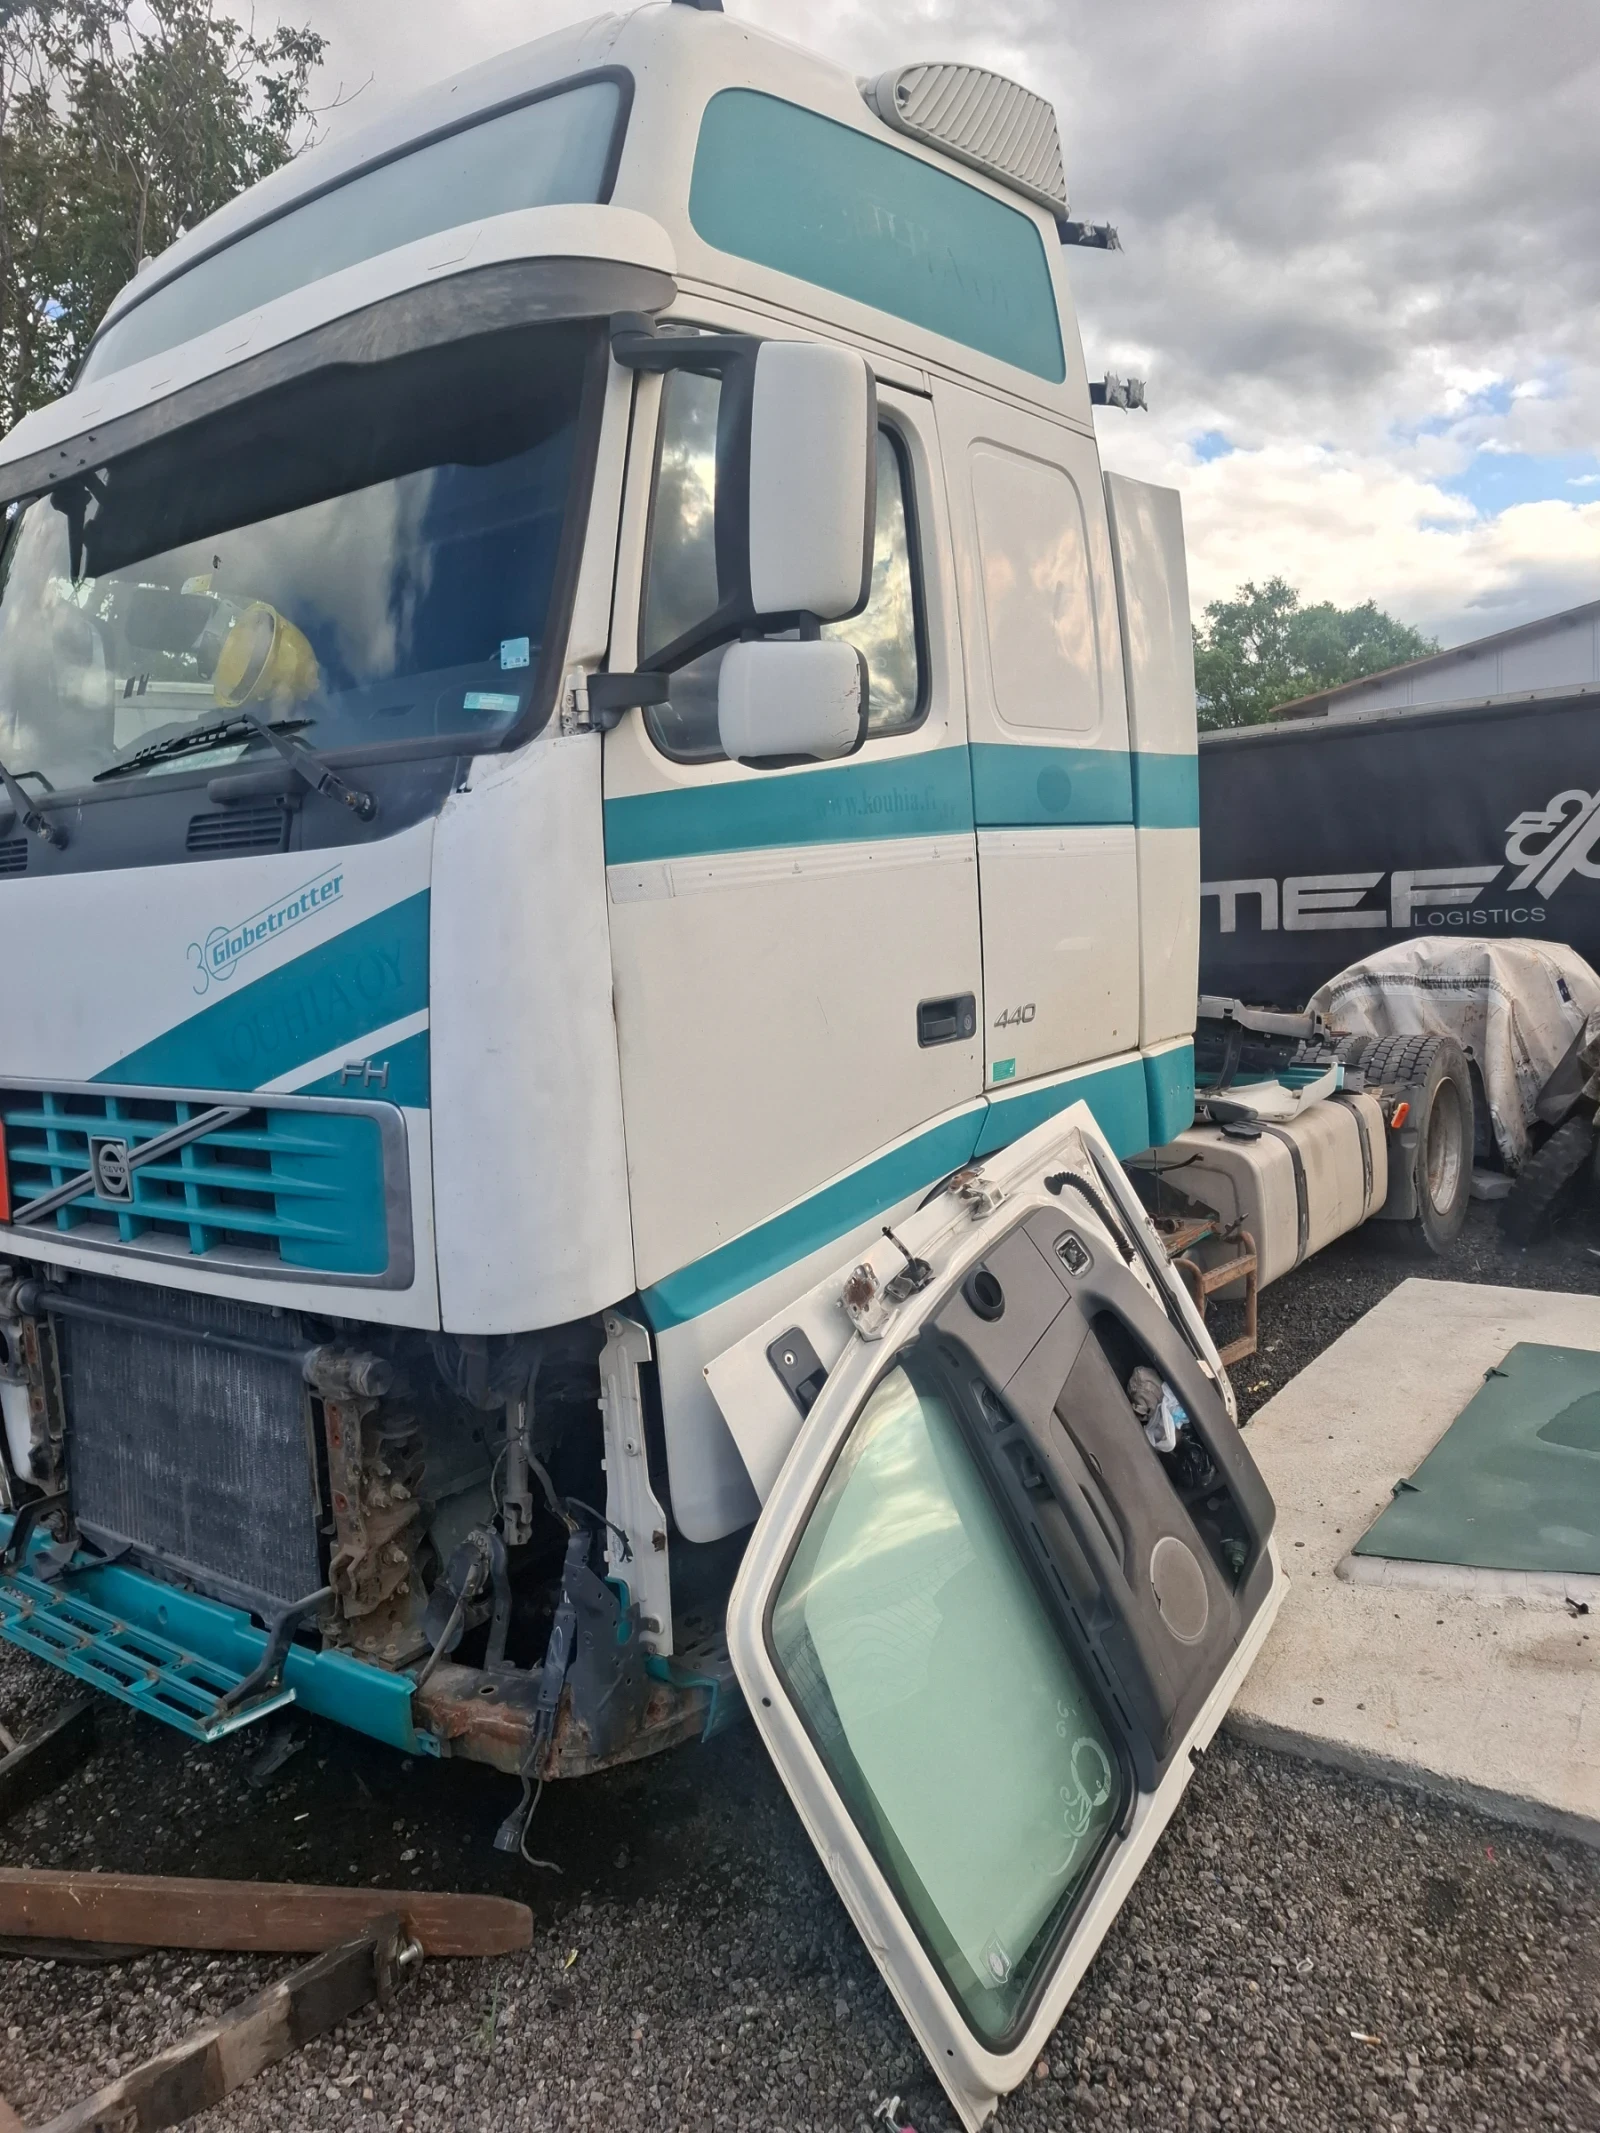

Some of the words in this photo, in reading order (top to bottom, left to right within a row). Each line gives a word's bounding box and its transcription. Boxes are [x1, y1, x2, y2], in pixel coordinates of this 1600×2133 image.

[213, 875, 343, 966] Globetrotter
[1414, 907, 1546, 927] LOGISTICS
[994, 1003, 1036, 1028] 440
[341, 1058, 389, 1088] FH
